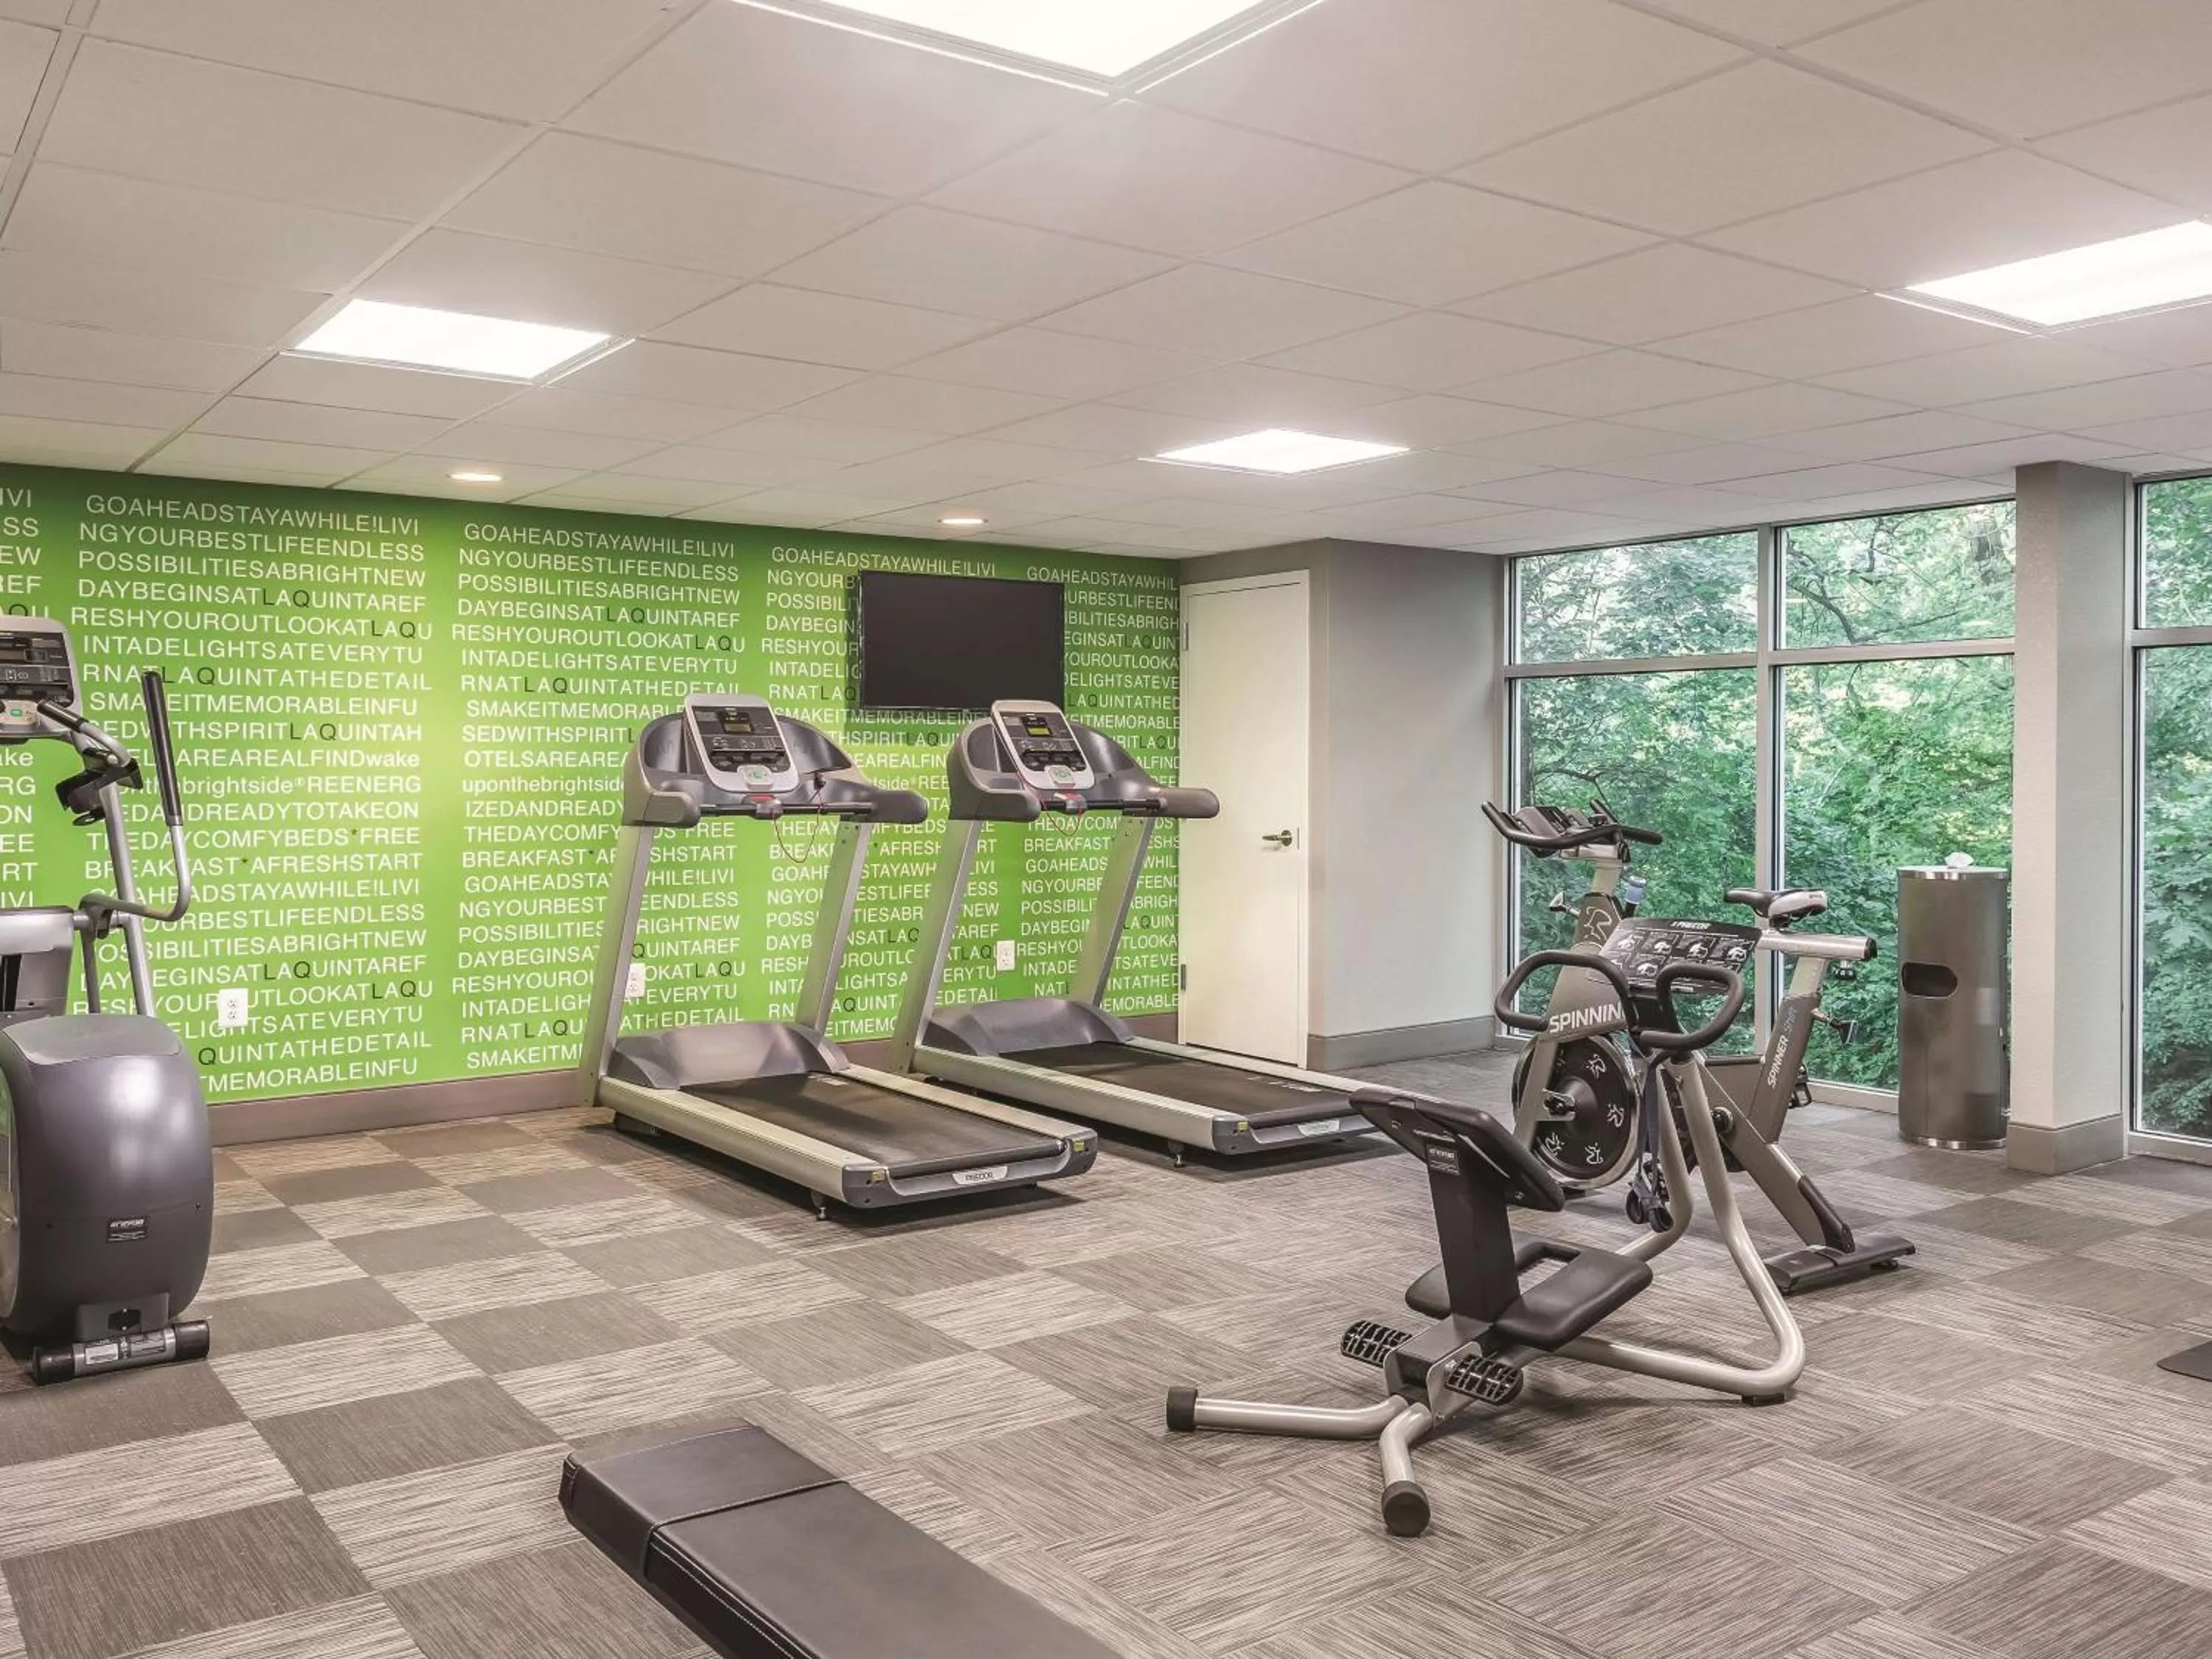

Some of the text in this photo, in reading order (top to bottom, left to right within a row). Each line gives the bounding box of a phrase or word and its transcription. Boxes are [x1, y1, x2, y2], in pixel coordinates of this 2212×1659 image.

[3, 517, 39, 537] SS
[80, 523, 425, 561] NGYOURBESTLIFEENDLESS
[79, 551, 426, 587] POSSIBILITIESABRIGHTNEW
[459, 549, 738, 582] NGYOURBESTLIFEENDLESS
[0, 574, 42, 594] EF
[79, 580, 426, 613] DAYBEGINSATLAQUINTAREF
[459, 574, 740, 605] POSSIBILITIESABRIGHTNEW
[72, 608, 432, 639] RESHYOUROUTLOOKATLAQU
[458, 599, 740, 628] DAYBEGINSATLAQUINTAREF
[83, 636, 423, 664] INTADELIGHTSATEVERYTU
[452, 624, 745, 653] RESHYOUROUTLOOKATLAQU
[462, 650, 737, 674] INTADELIGHTSATEVERYTU
[90, 692, 417, 715] SMAEITMEMORABLEINFU
[0, 748, 33, 766] ke
[3, 863, 38, 881] RT
[1549, 1001, 1626, 1033] SPINNIN
[1767, 1034, 1790, 1089] SPINNER
